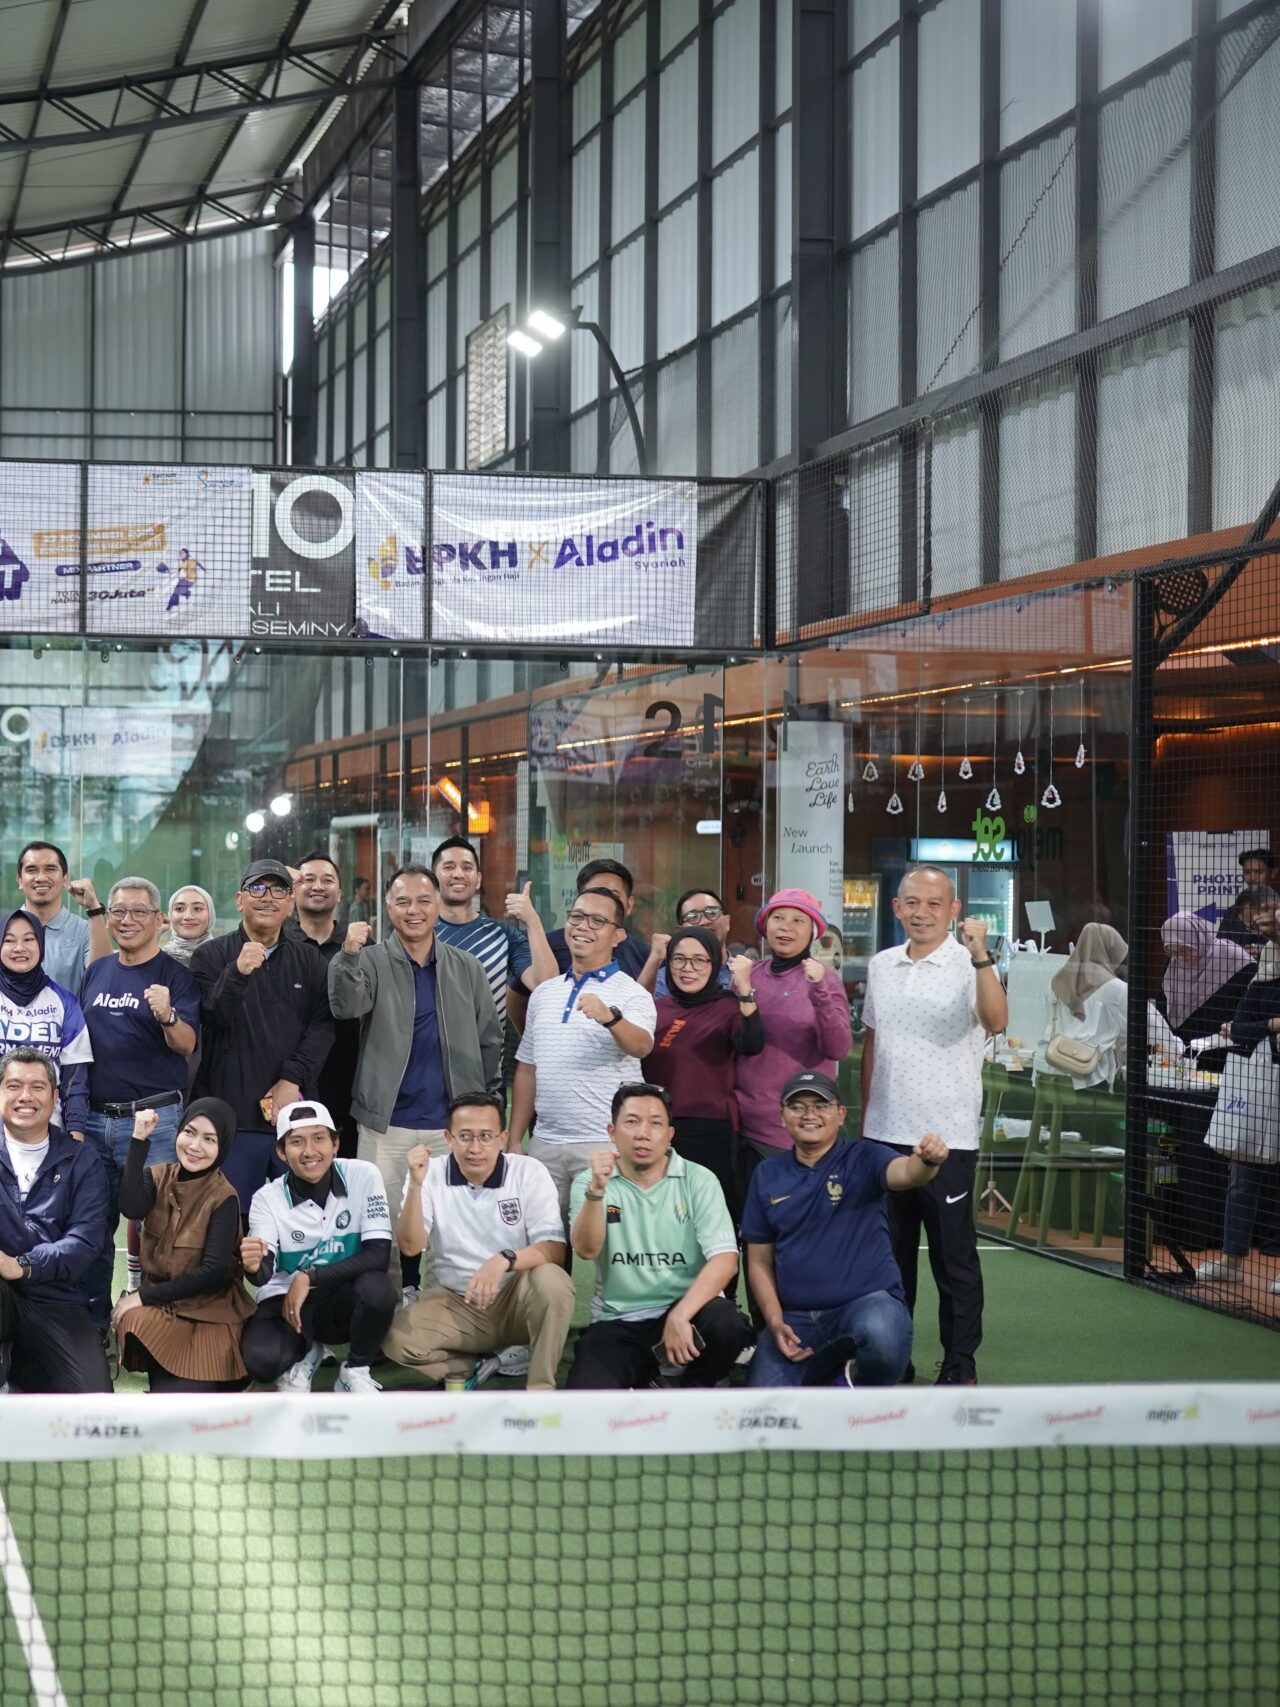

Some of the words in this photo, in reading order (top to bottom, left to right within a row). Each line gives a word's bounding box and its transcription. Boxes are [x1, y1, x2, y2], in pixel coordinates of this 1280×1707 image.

[553, 520, 685, 569] Aladin
[634, 560, 686, 573] Syariah
[806, 753, 839, 777] Earth
[805, 777, 839, 793] Love
[809, 792, 838, 809] Life
[783, 827, 808, 838] New
[790, 843, 832, 853] Launch
[1193, 874, 1244, 884] PHOTO
[1198, 885, 1242, 896] PRINT
[92, 992, 140, 1009] Aladin
[612, 1252, 687, 1266] AMITRA
[737, 1414, 804, 1431] PADEL
[73, 1423, 144, 1440] PADEL
